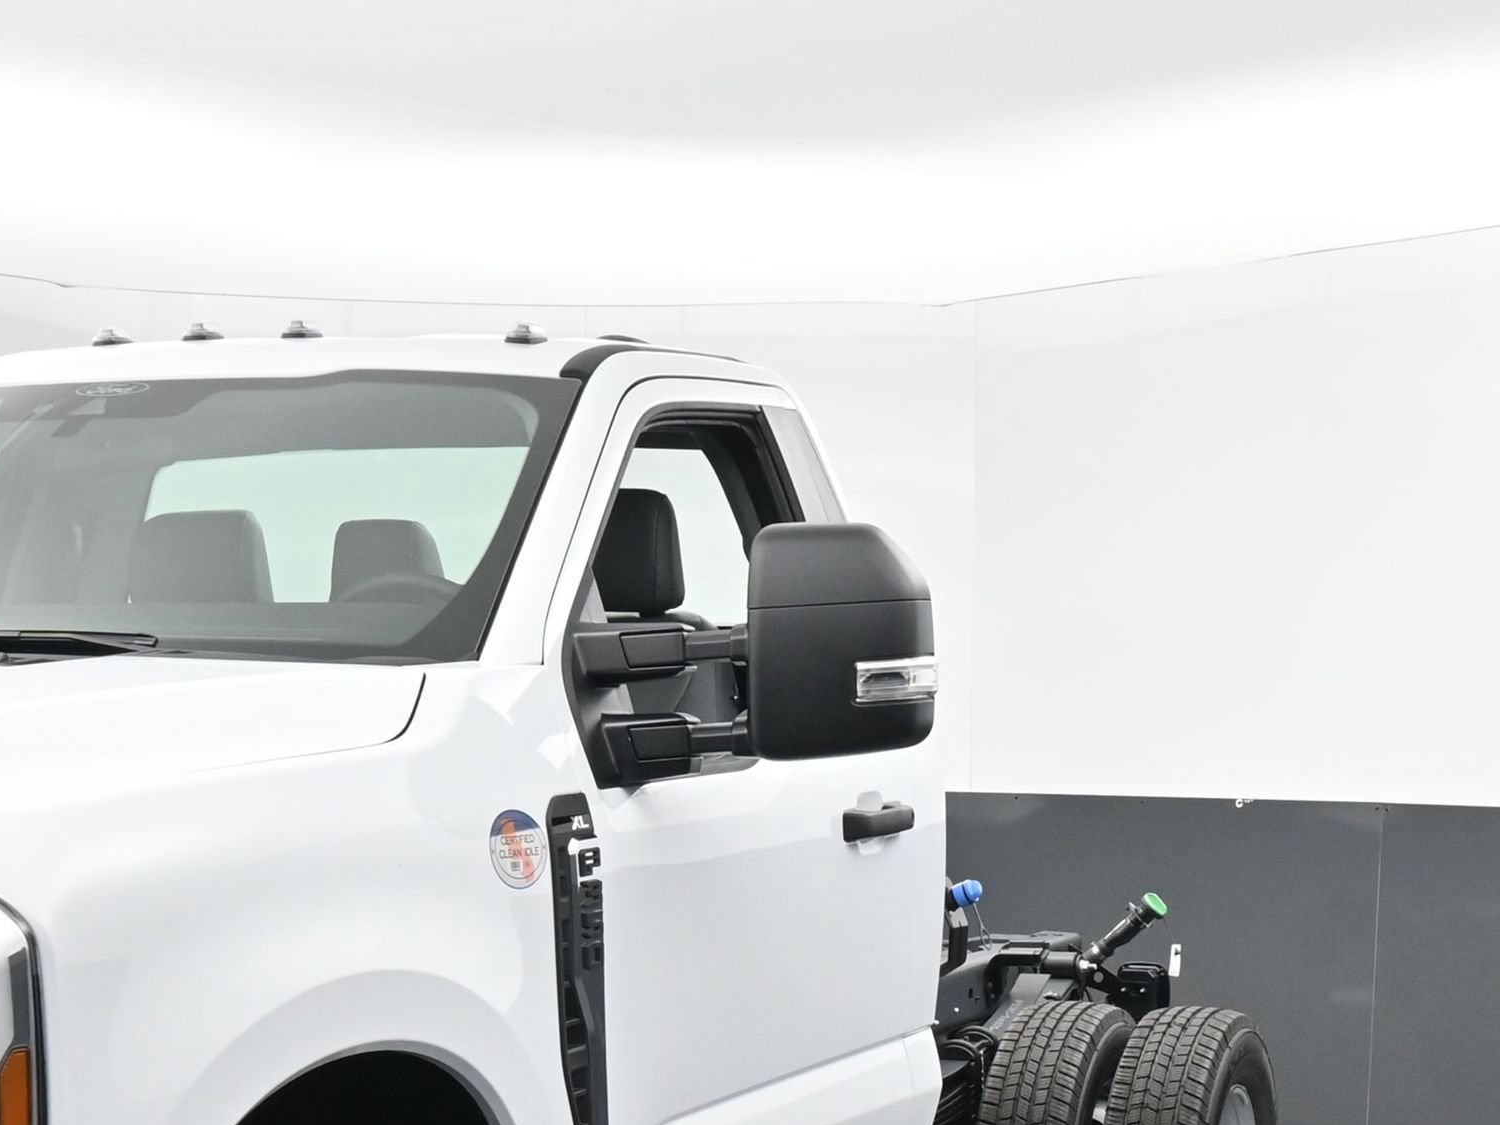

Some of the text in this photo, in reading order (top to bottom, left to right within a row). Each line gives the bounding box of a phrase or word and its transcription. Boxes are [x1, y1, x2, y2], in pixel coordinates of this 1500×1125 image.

[571, 815, 590, 831] XL
[500, 834, 536, 846] CERTIFIED
[499, 846, 540, 860] CLEAN IDLE
